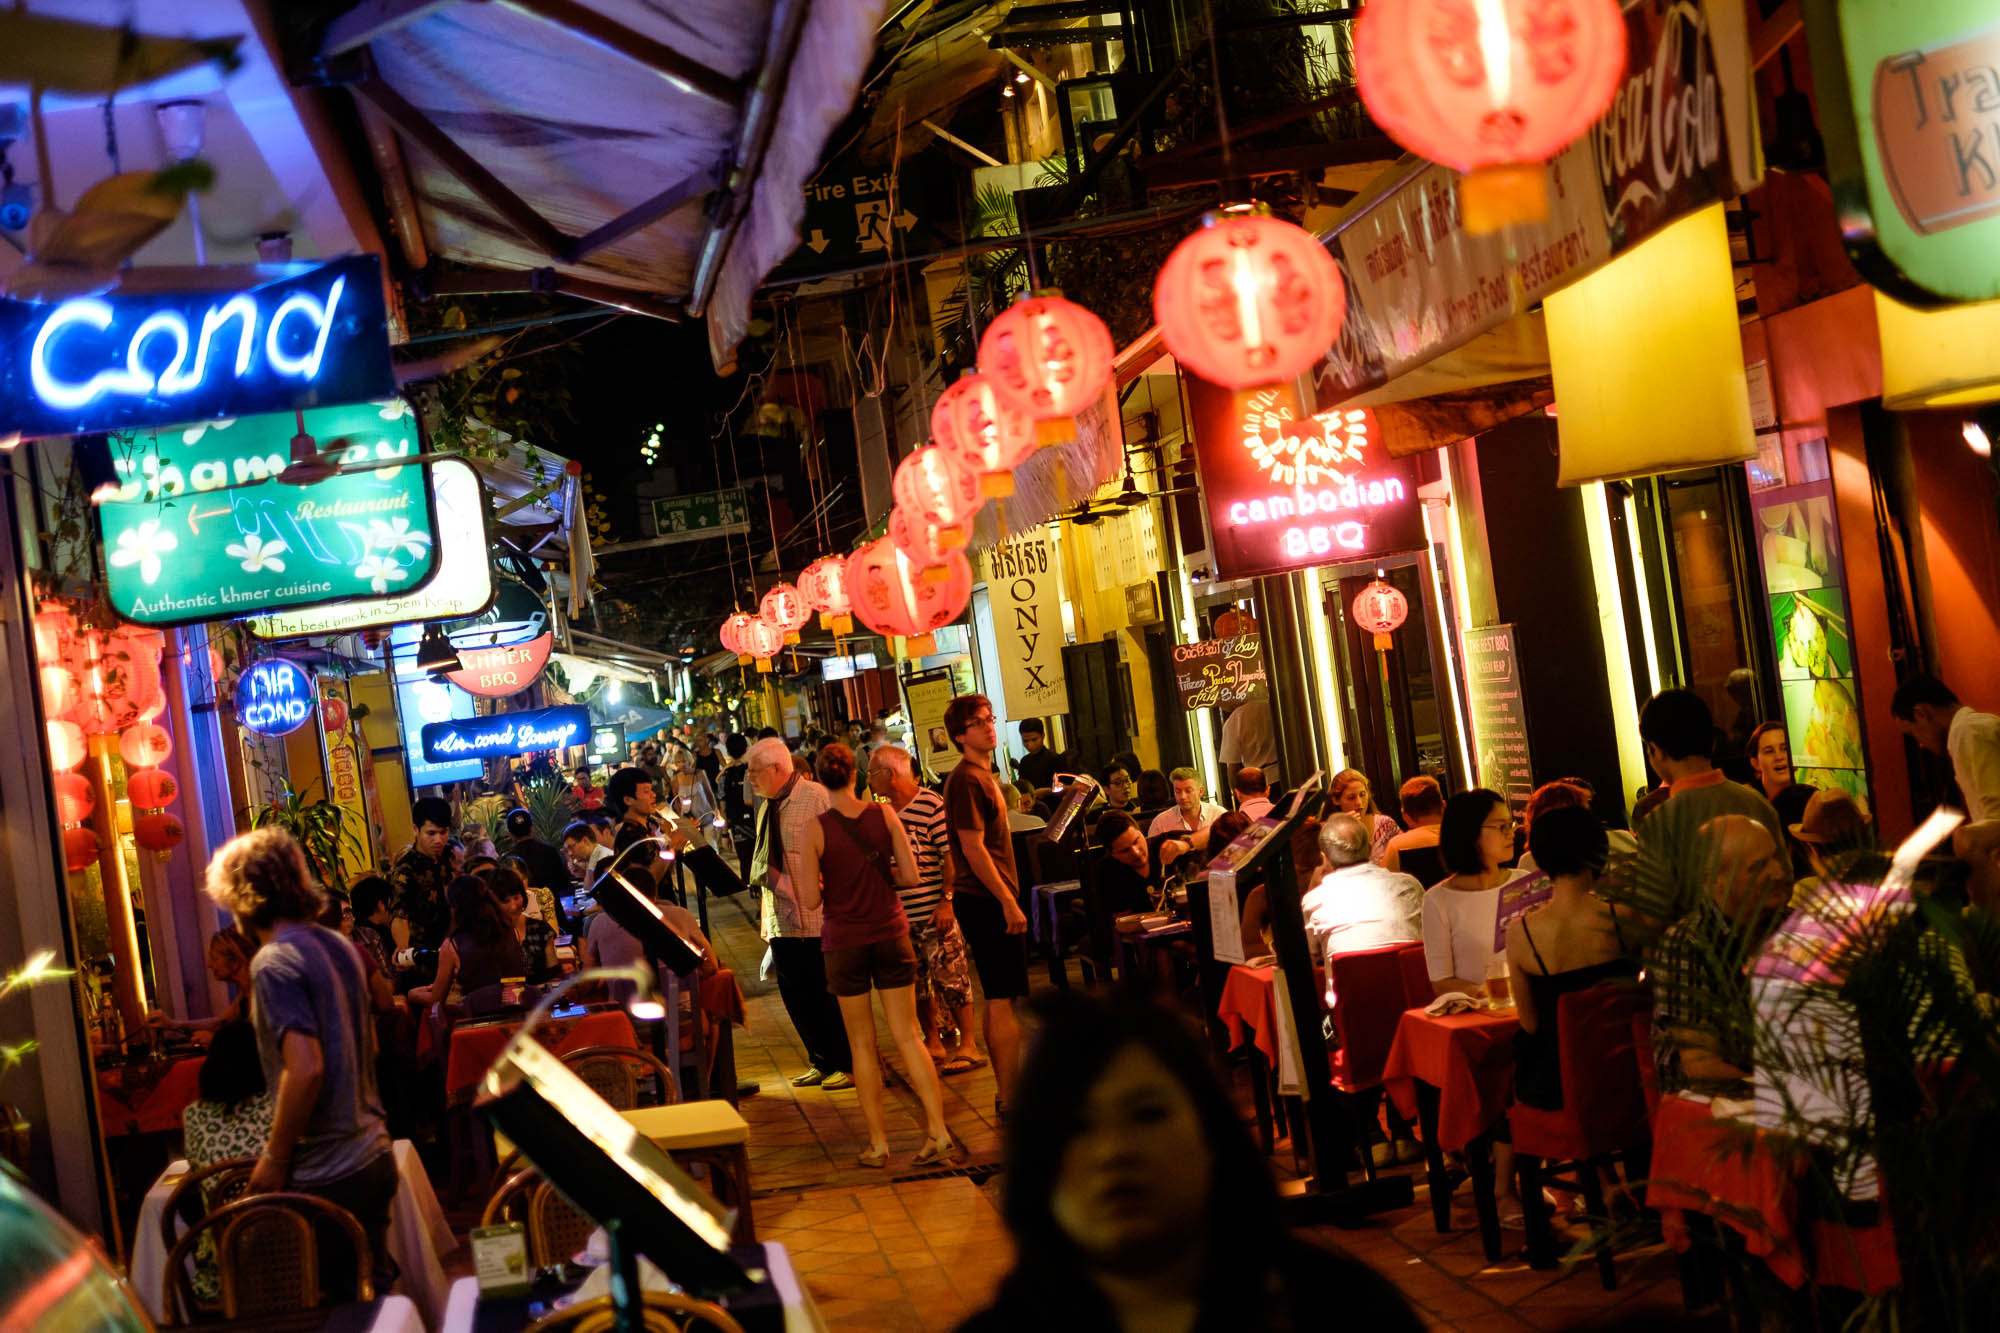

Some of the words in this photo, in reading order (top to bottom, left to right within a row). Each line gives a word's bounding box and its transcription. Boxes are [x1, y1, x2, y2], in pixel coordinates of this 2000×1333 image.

[1952, 121, 2000, 197] K
[1517, 216, 1590, 292] estaurant
[30, 274, 347, 408] Cond
[294, 491, 409, 521] Restaurant
[1230, 474, 1404, 525] cambodian
[1285, 520, 1365, 558] BBQ
[130, 592, 218, 618] Authentic
[220, 585, 271, 606] khmer
[275, 579, 332, 598] cuisine
[267, 616, 297, 633] The
[300, 619, 329, 633] best
[369, 606, 382, 617] in
[385, 597, 421, 614] Siem
[424, 594, 463, 612] Reap
[461, 648, 533, 671] KHMER
[1495, 634, 1510, 652] BBQ
[251, 667, 295, 698] AIR
[479, 671, 519, 688] BBQ
[1176, 673, 1206, 692] Frozen
[245, 700, 306, 725] COND
